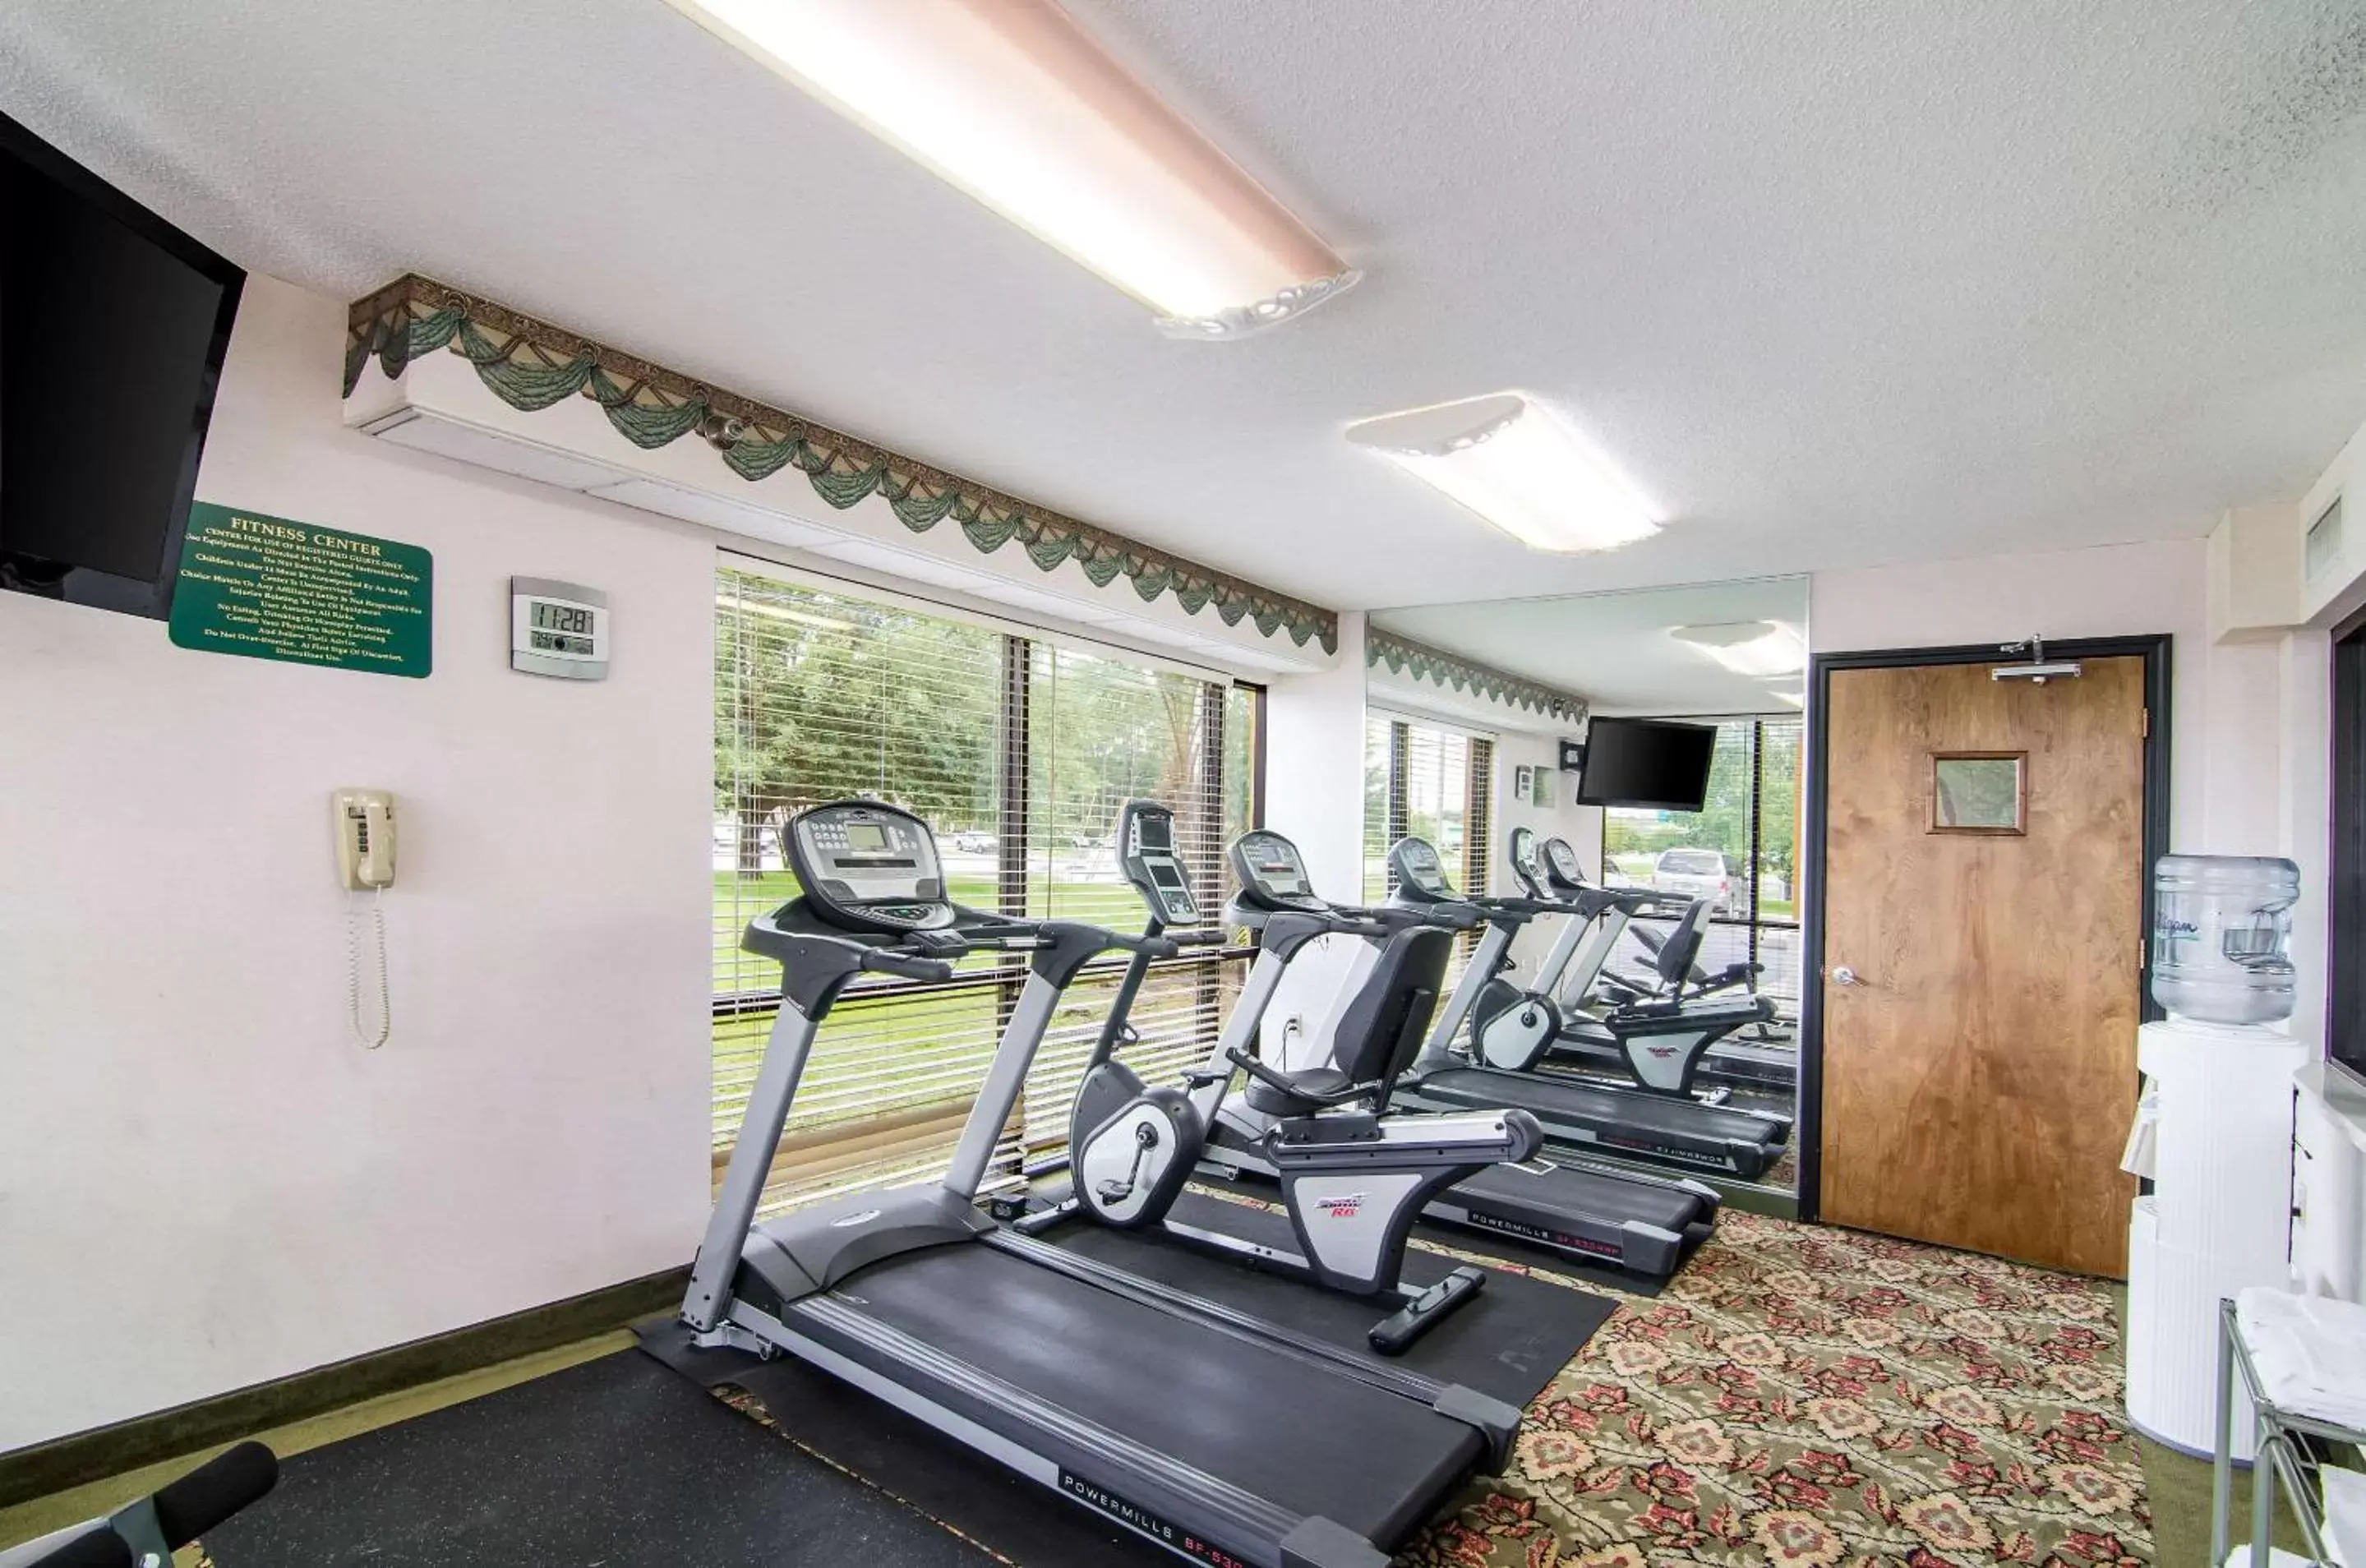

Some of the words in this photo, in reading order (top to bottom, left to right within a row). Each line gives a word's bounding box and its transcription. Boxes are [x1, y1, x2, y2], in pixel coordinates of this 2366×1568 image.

[205, 528, 242, 540] CENTER
[231, 517, 306, 542] FITNESS
[314, 534, 380, 556] CENTER
[217, 602, 231, 611] No
[1063, 1475, 1172, 1540] POWERMILLS
